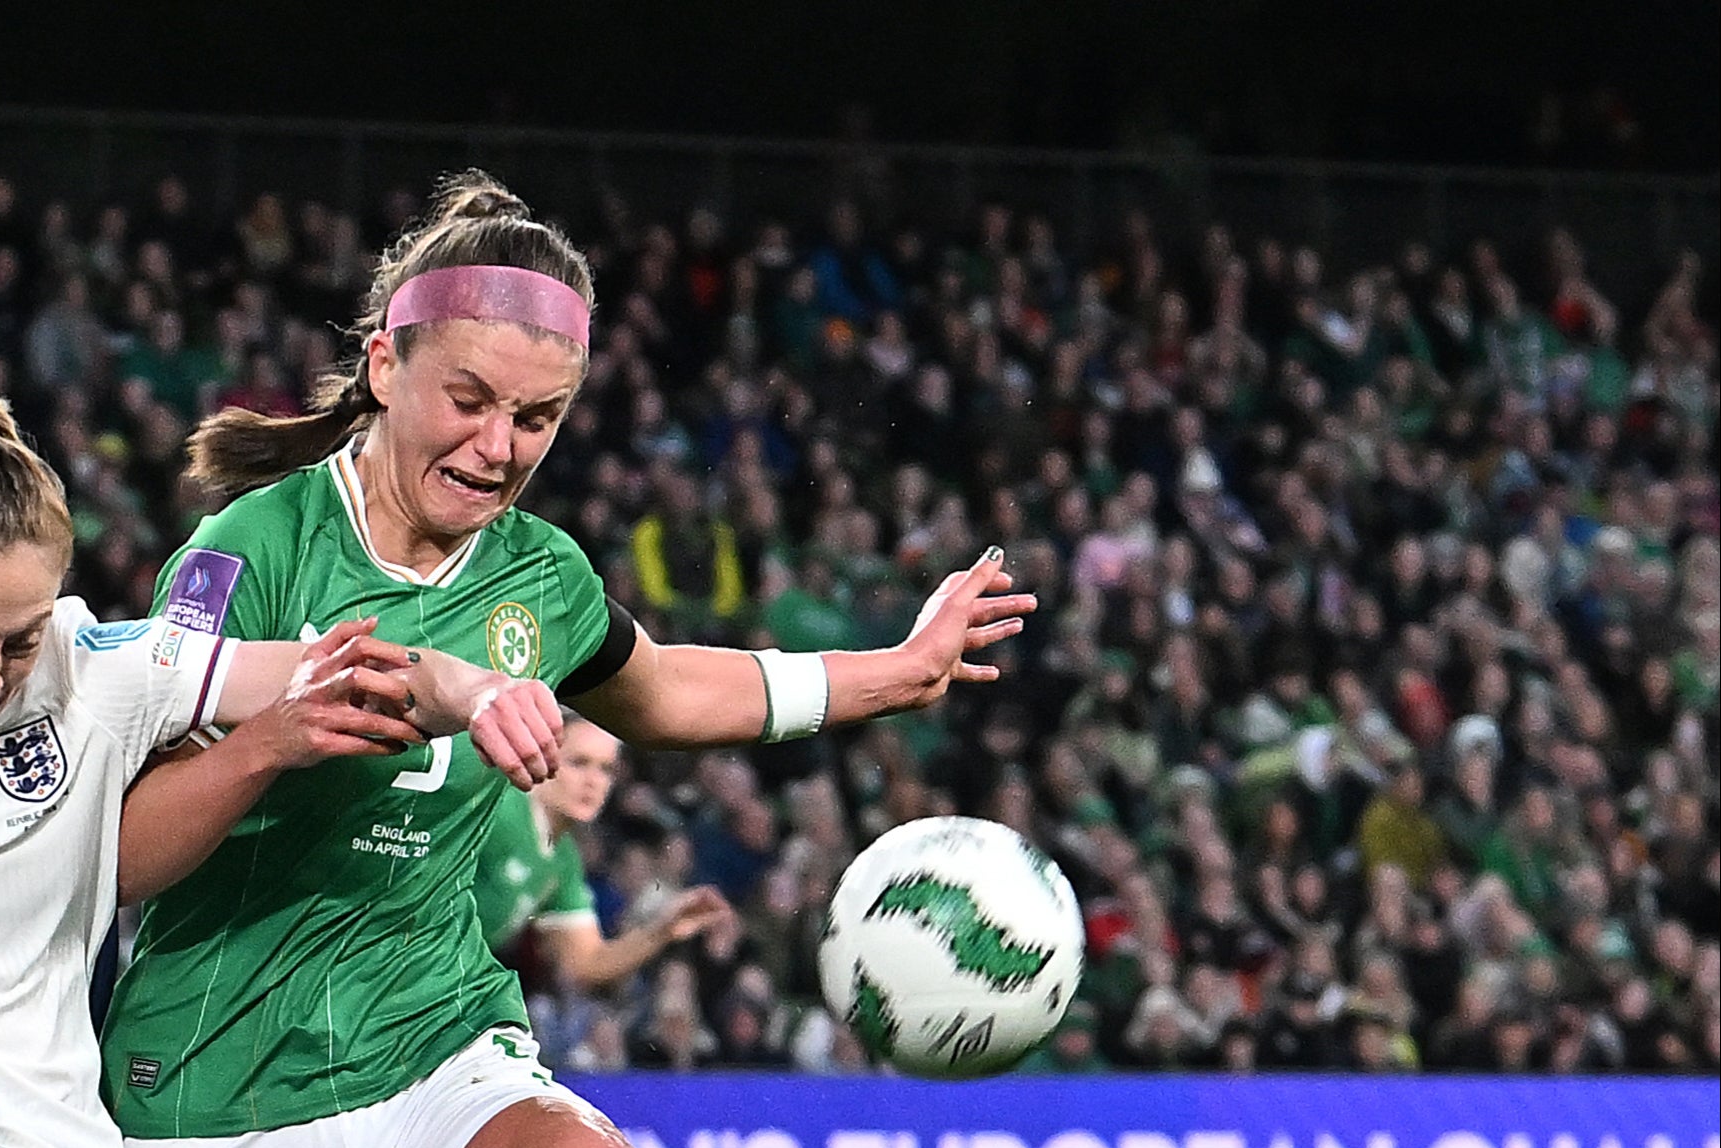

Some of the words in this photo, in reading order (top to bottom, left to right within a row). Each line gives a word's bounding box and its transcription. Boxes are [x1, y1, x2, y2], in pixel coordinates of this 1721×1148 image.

[371, 824, 431, 843] ENGLAND
[352, 837, 374, 852] 9th
[374, 841, 410, 858] APRIL
